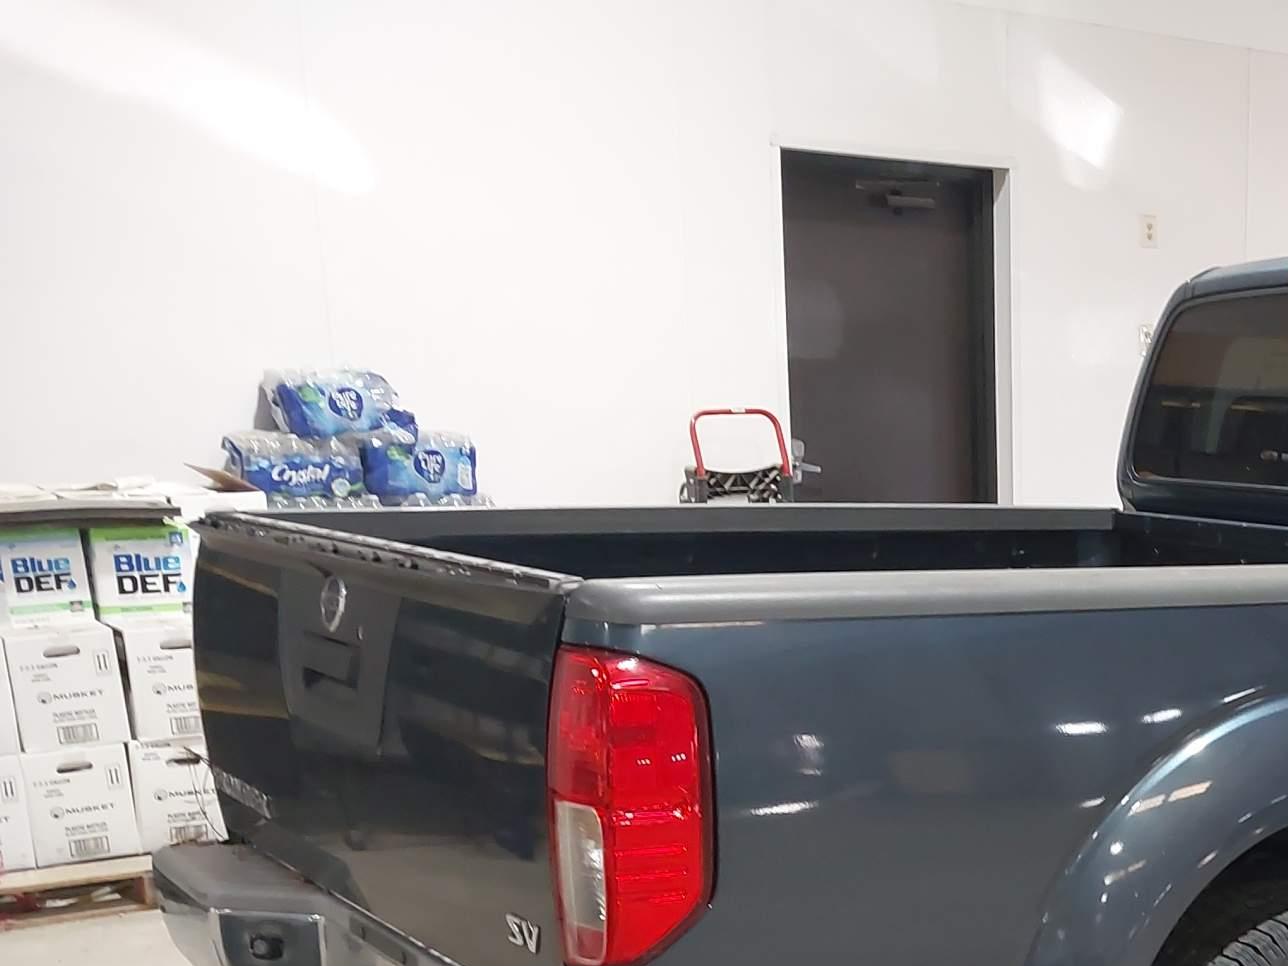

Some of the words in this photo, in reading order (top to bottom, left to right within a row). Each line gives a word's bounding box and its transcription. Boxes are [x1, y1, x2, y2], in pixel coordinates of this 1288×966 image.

[11, 557, 71, 575] Blue
[113, 553, 182, 573] Blue
[14, 572, 73, 594] DEF
[116, 573, 182, 595] DEF
[505, 913, 541, 954] SV
